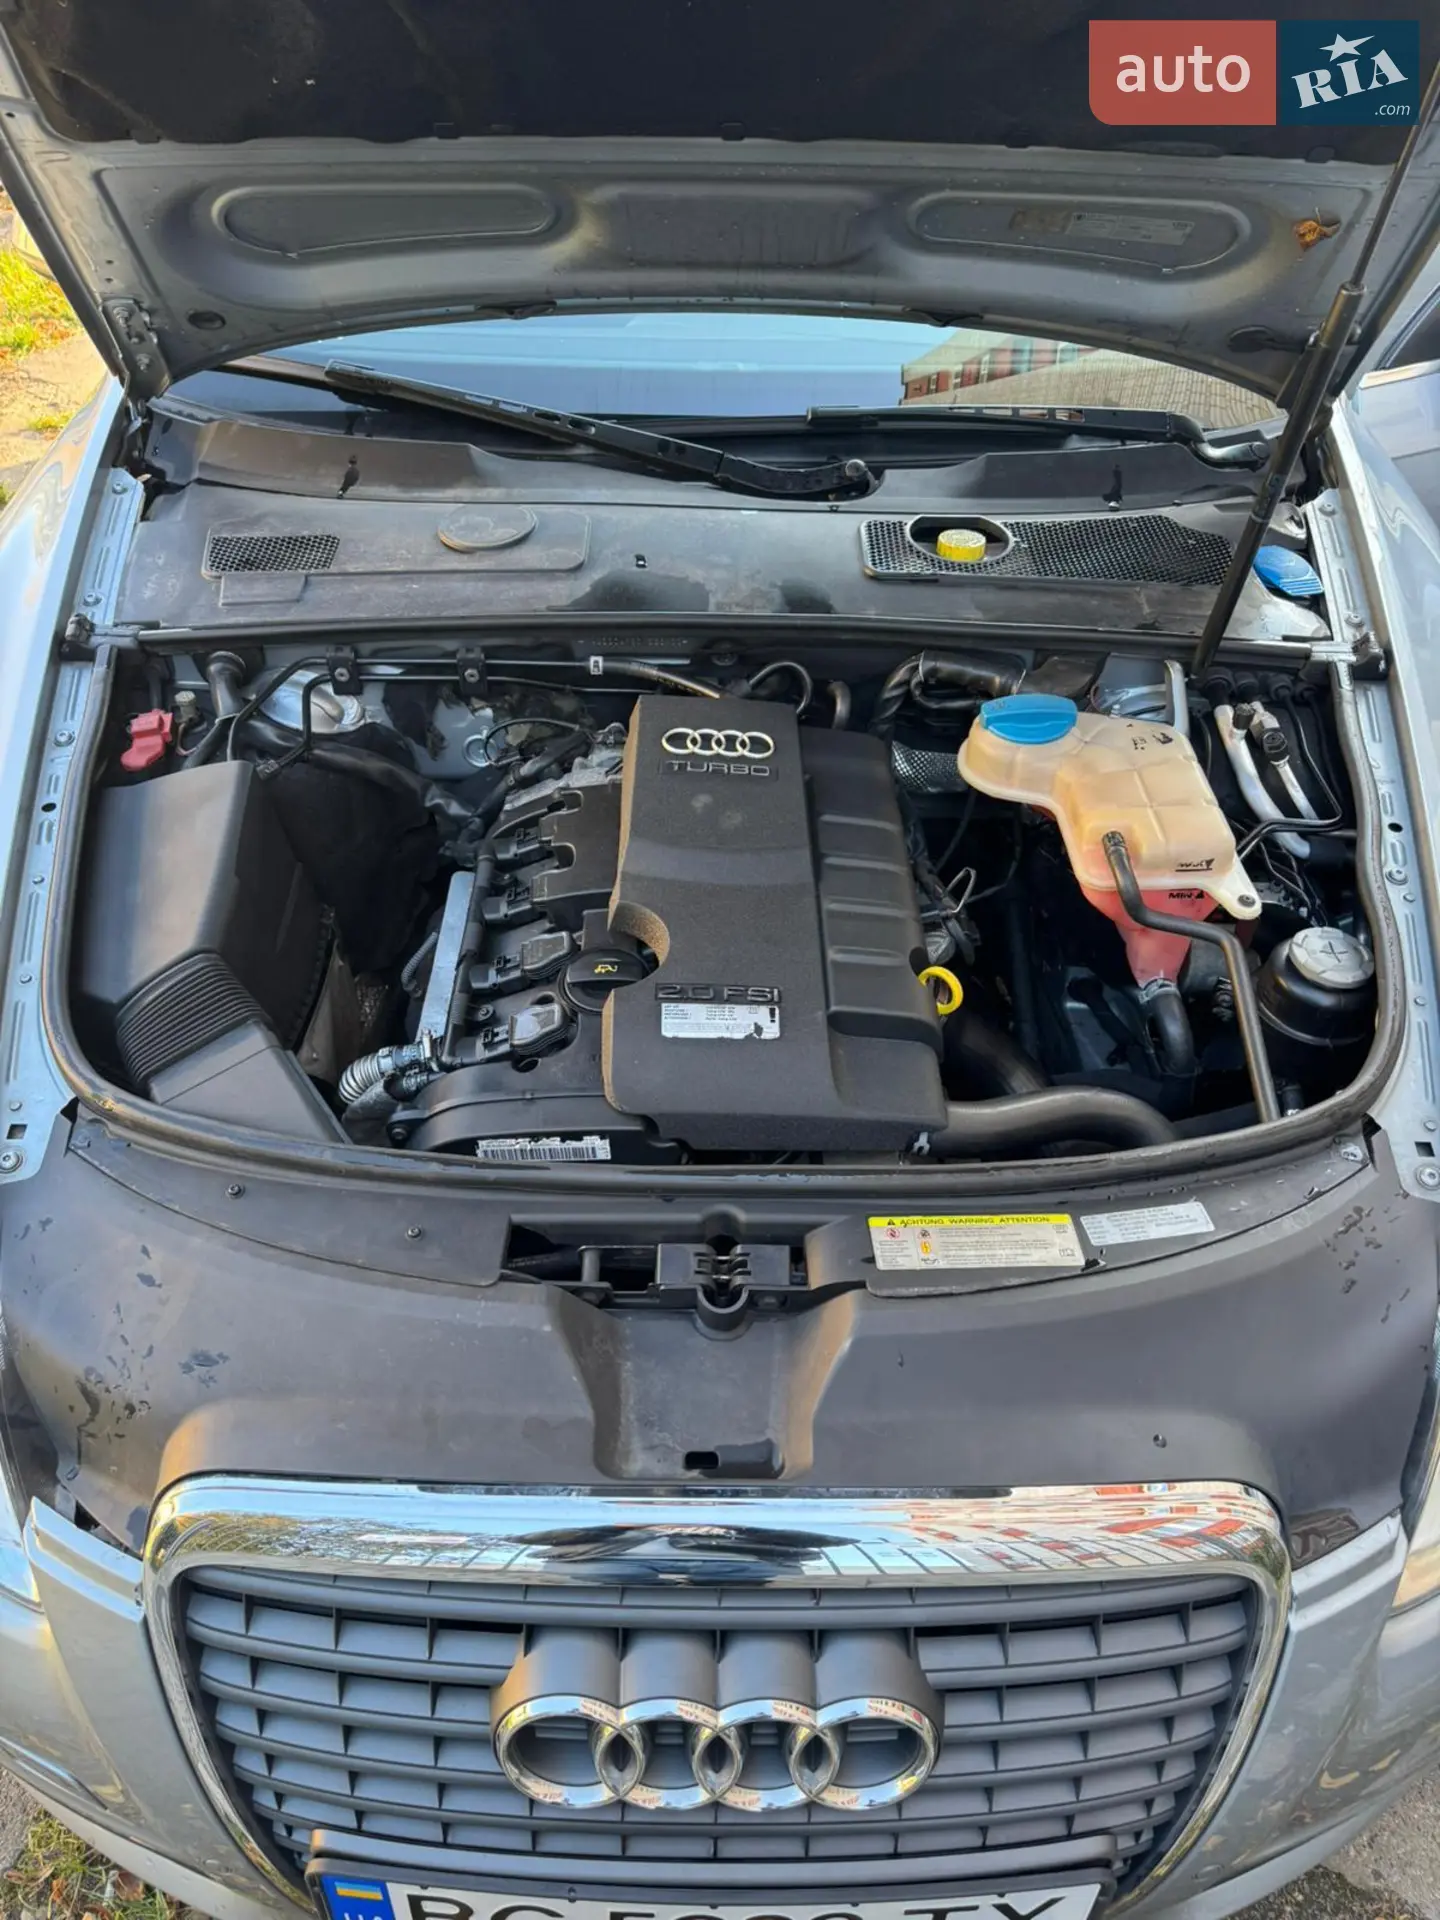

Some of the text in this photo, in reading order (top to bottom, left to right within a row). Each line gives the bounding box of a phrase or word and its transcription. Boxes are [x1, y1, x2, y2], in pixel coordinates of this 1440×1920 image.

[665, 759, 770, 777] TURBO
[656, 984, 780, 1003] 2.0 FSI
[899, 1216, 1050, 1227] ACHTUNG WARNING ATTENTION
